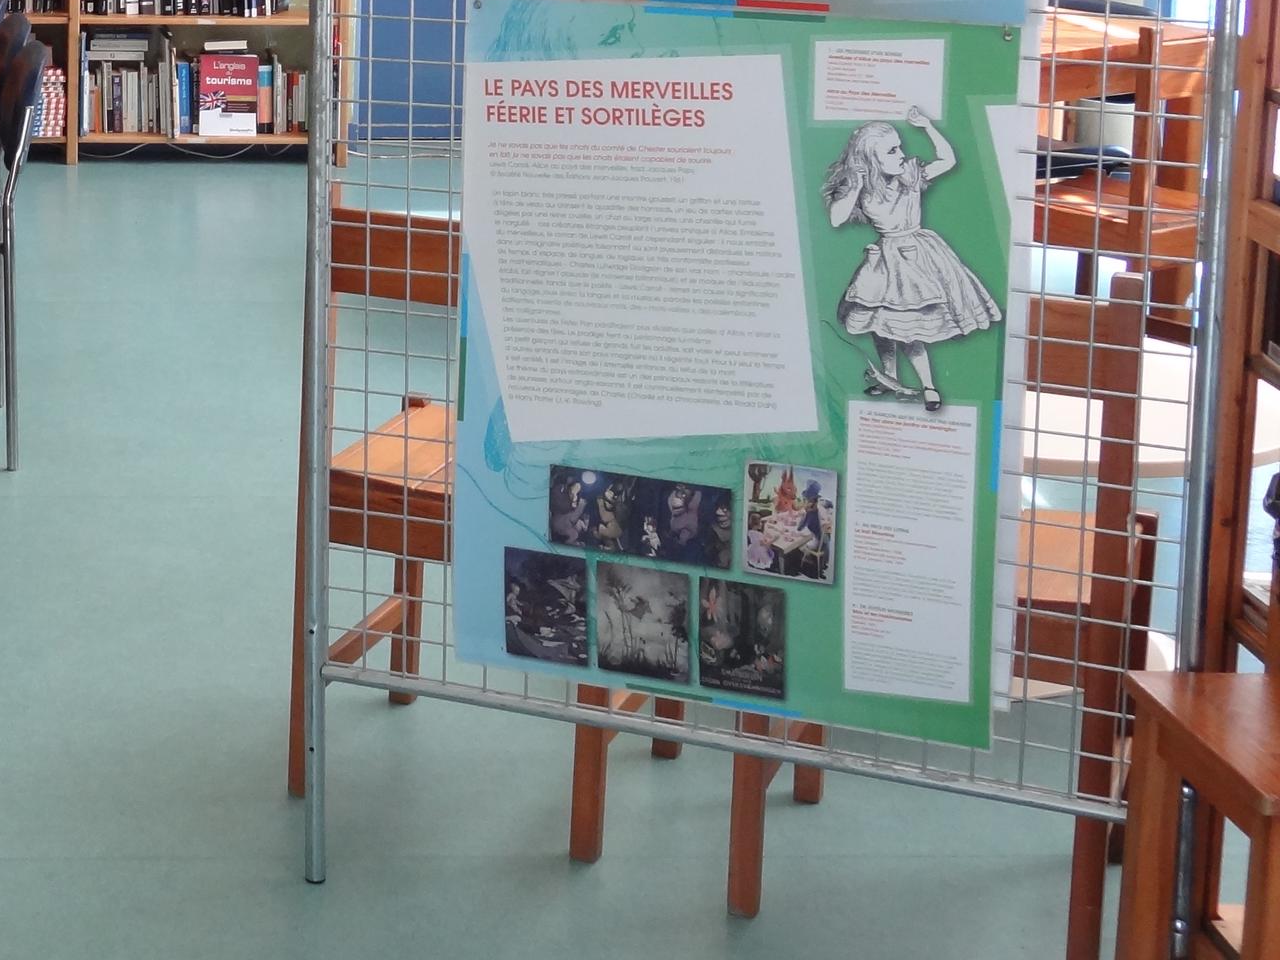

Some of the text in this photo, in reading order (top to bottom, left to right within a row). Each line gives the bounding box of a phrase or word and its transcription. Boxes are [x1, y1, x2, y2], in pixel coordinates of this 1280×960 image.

[206, 76, 252, 85] tourisme
[485, 78, 734, 101] LE PAYS DES MERVEILLES
[486, 100, 705, 127] FÉERIE ET SORTILÈGES
